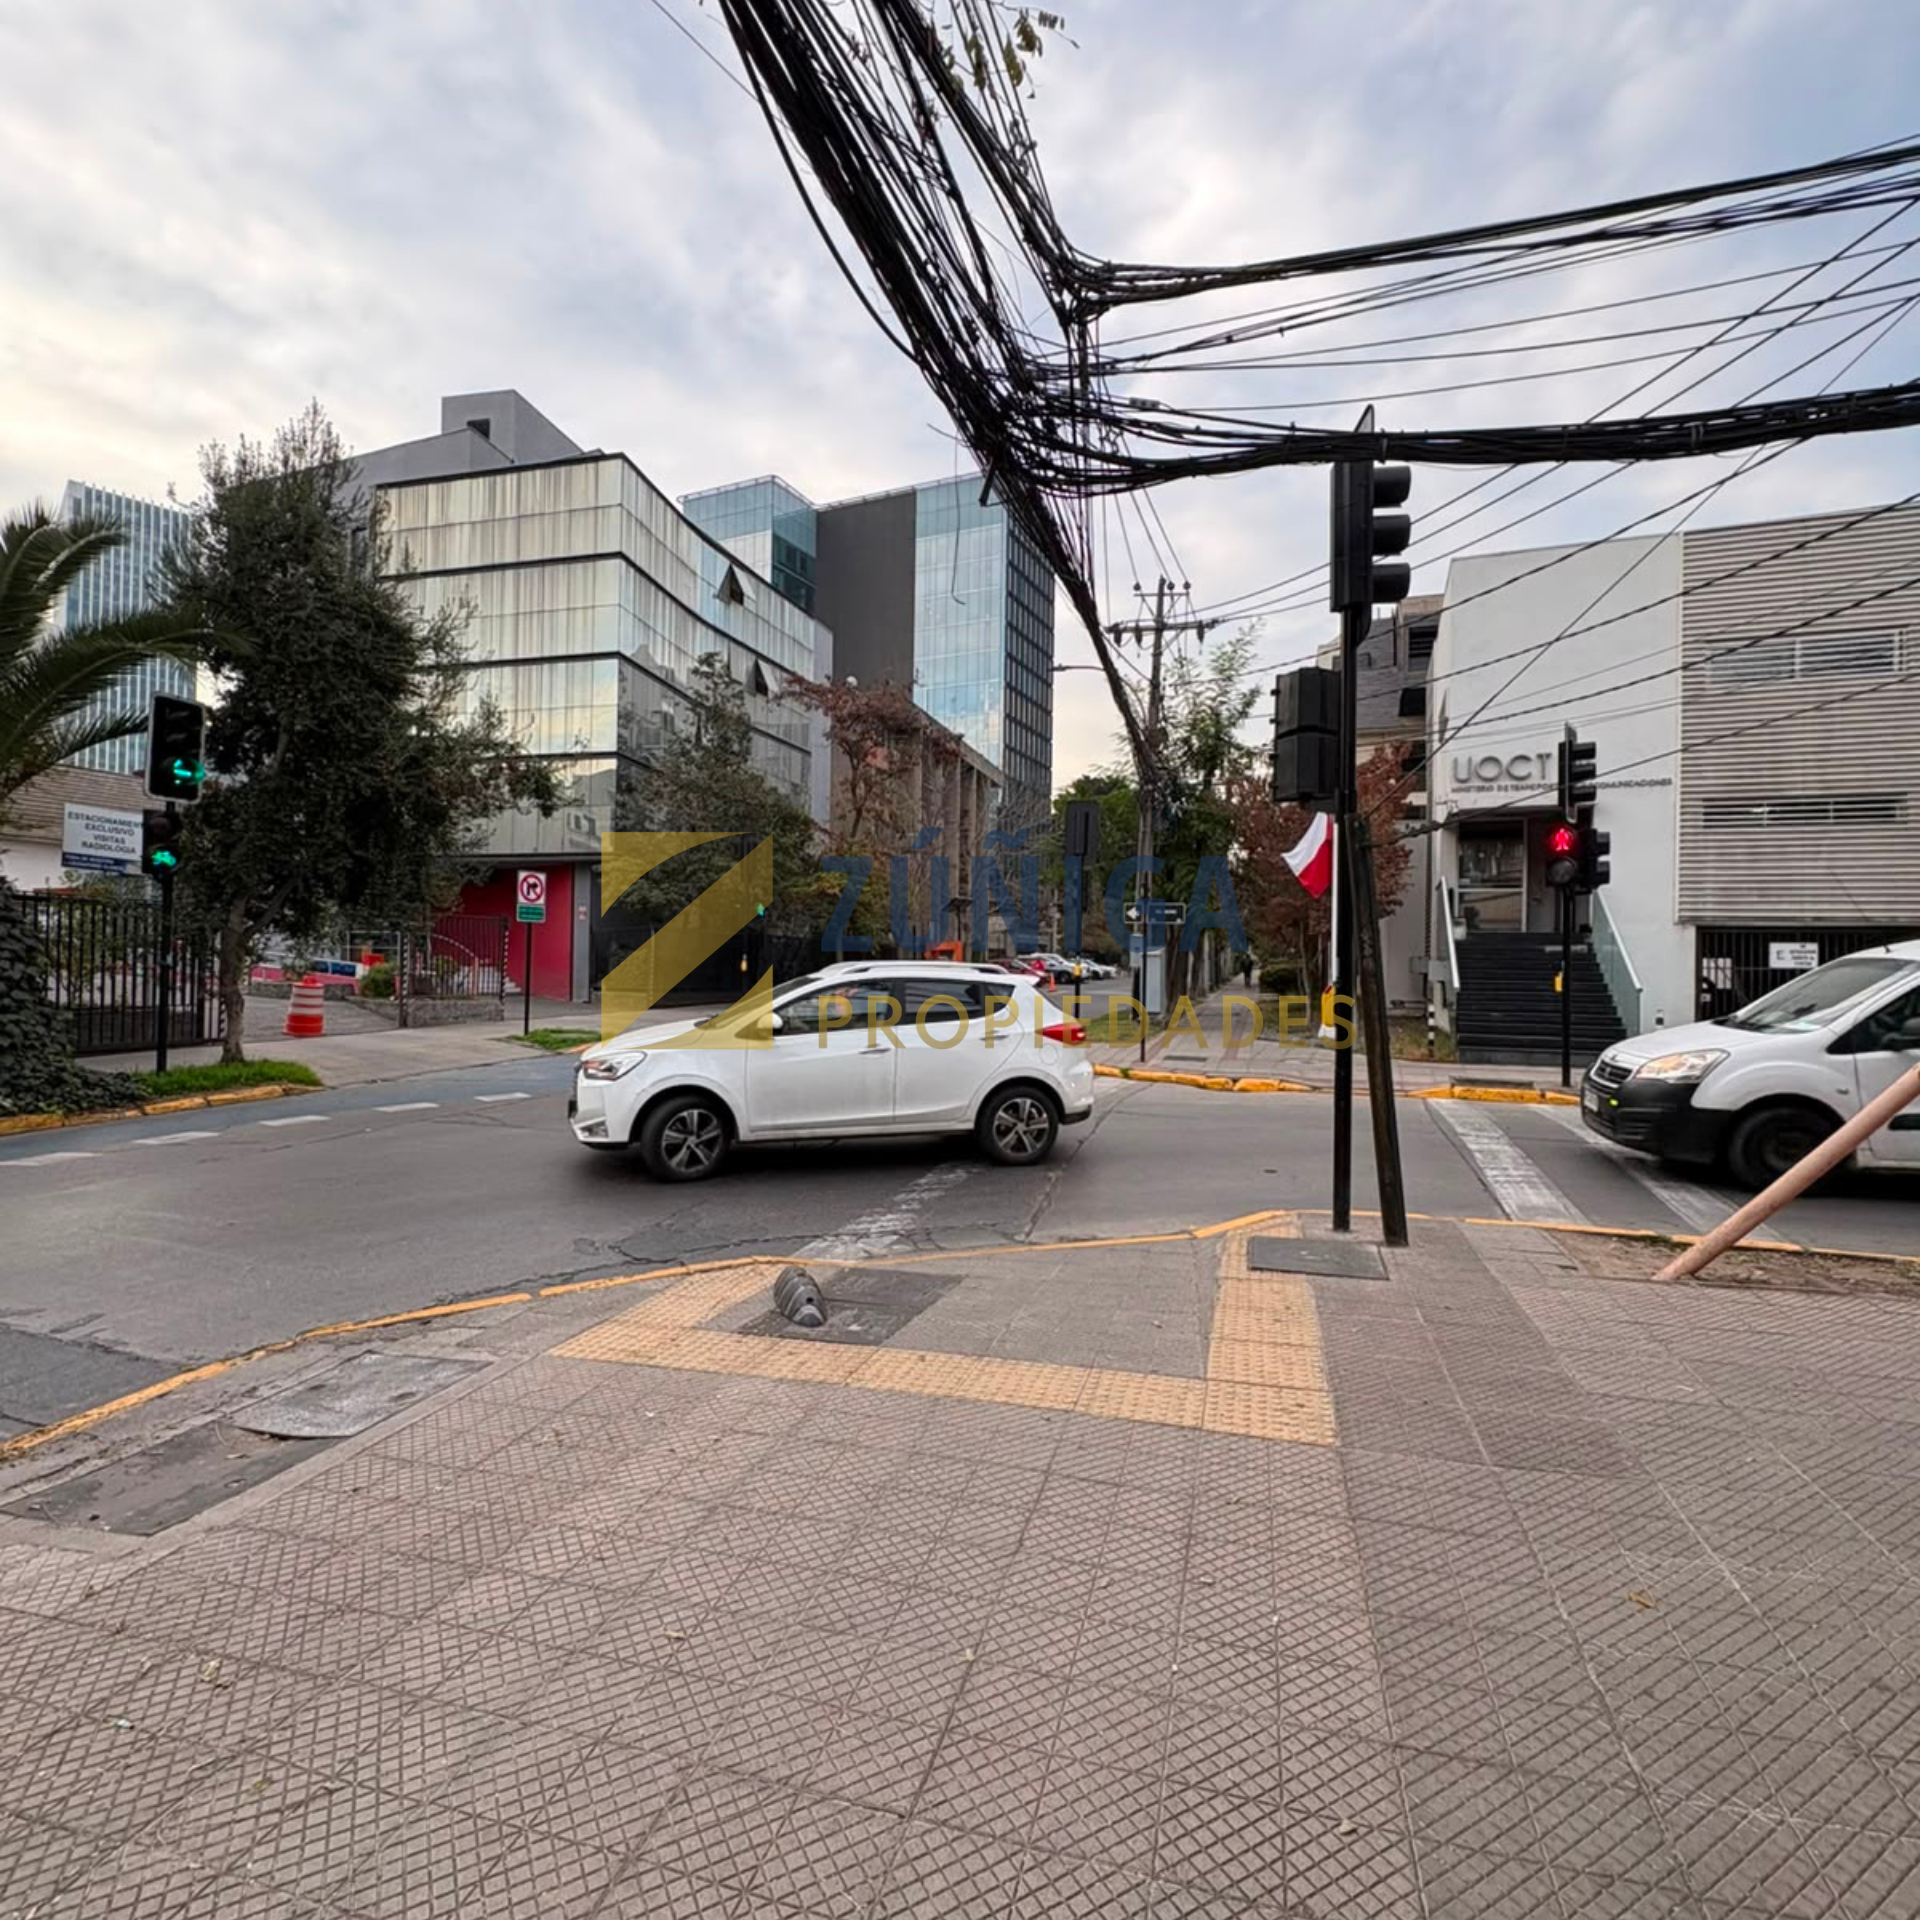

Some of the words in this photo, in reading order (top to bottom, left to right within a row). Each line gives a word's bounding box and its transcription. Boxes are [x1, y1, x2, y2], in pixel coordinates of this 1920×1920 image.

[1452, 753, 1552, 784] UOCT
[85, 822, 135, 837] EXCLUSIVO
[94, 834, 126, 845] VISITAS
